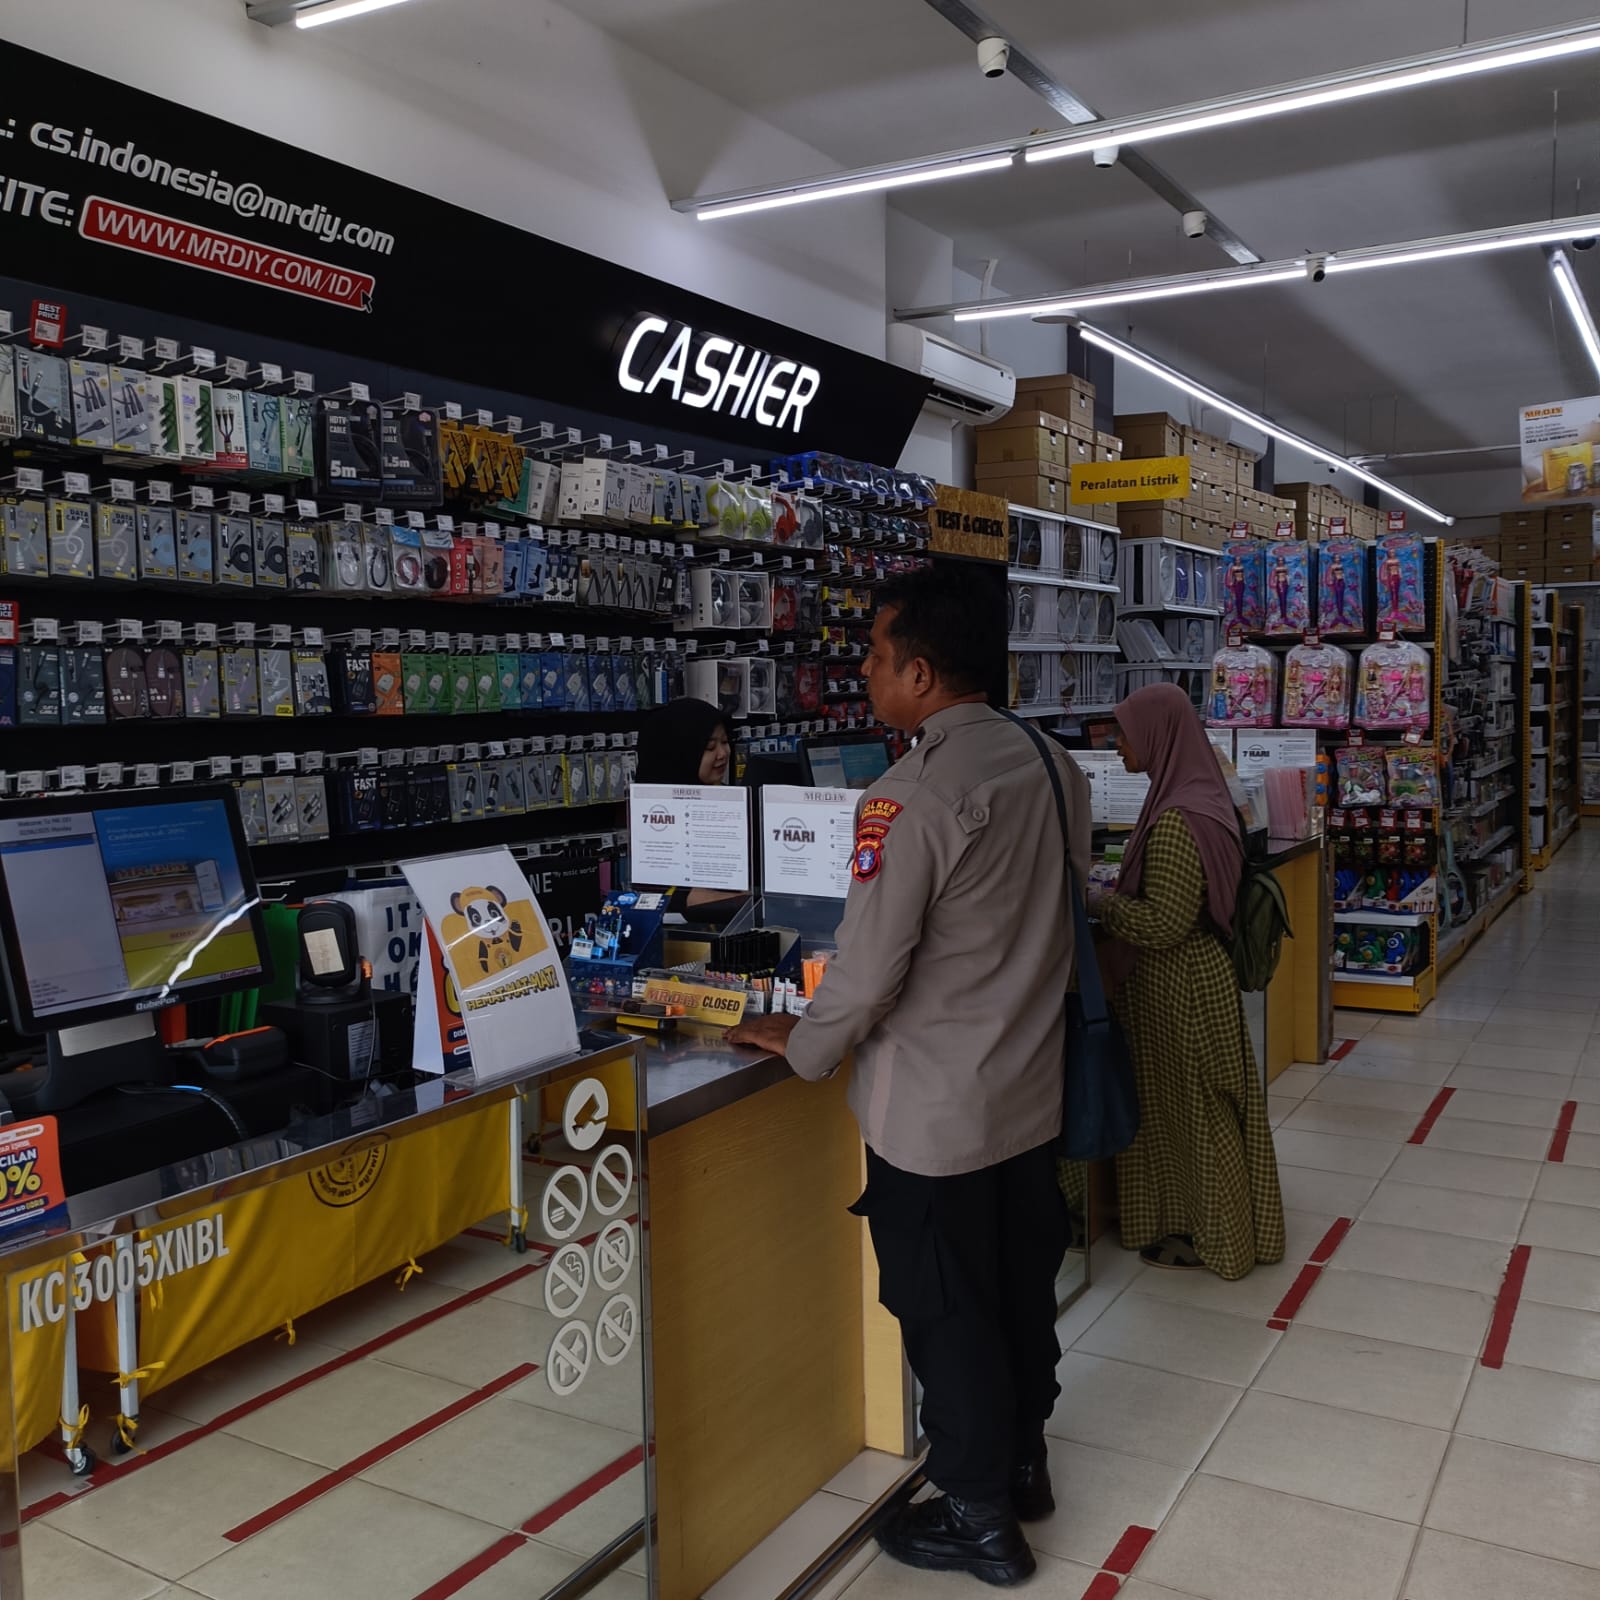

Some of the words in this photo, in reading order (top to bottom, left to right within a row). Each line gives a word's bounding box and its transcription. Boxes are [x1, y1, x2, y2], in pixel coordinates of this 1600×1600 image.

[30, 122, 395, 255] cs.indonesia@mrdiy.com
[97, 206, 362, 300] WWW.MRDIY.COM/ID/
[38, 303, 61, 314] BEST
[38, 310, 60, 320] PRICE
[618, 317, 820, 433] CASHIER
[329, 458, 357, 478] 5m
[1080, 478, 1137, 490] Peralatan
[1141, 474, 1179, 487] Listrik
[936, 509, 962, 530] TEST
[963, 514, 971, 532] &
[972, 516, 1004, 537] CHECK
[346, 659, 370, 671] FAST
[353, 777, 377, 790] FAST
[642, 815, 648, 824] 7
[650, 815, 675, 825] HARI
[773, 830, 781, 841] 7
[783, 830, 815, 843] HARI
[702, 995, 740, 1012] CLOSED
[22, 1271, 66, 1333] KC
[74, 1213, 230, 1312] 3005XNBL
